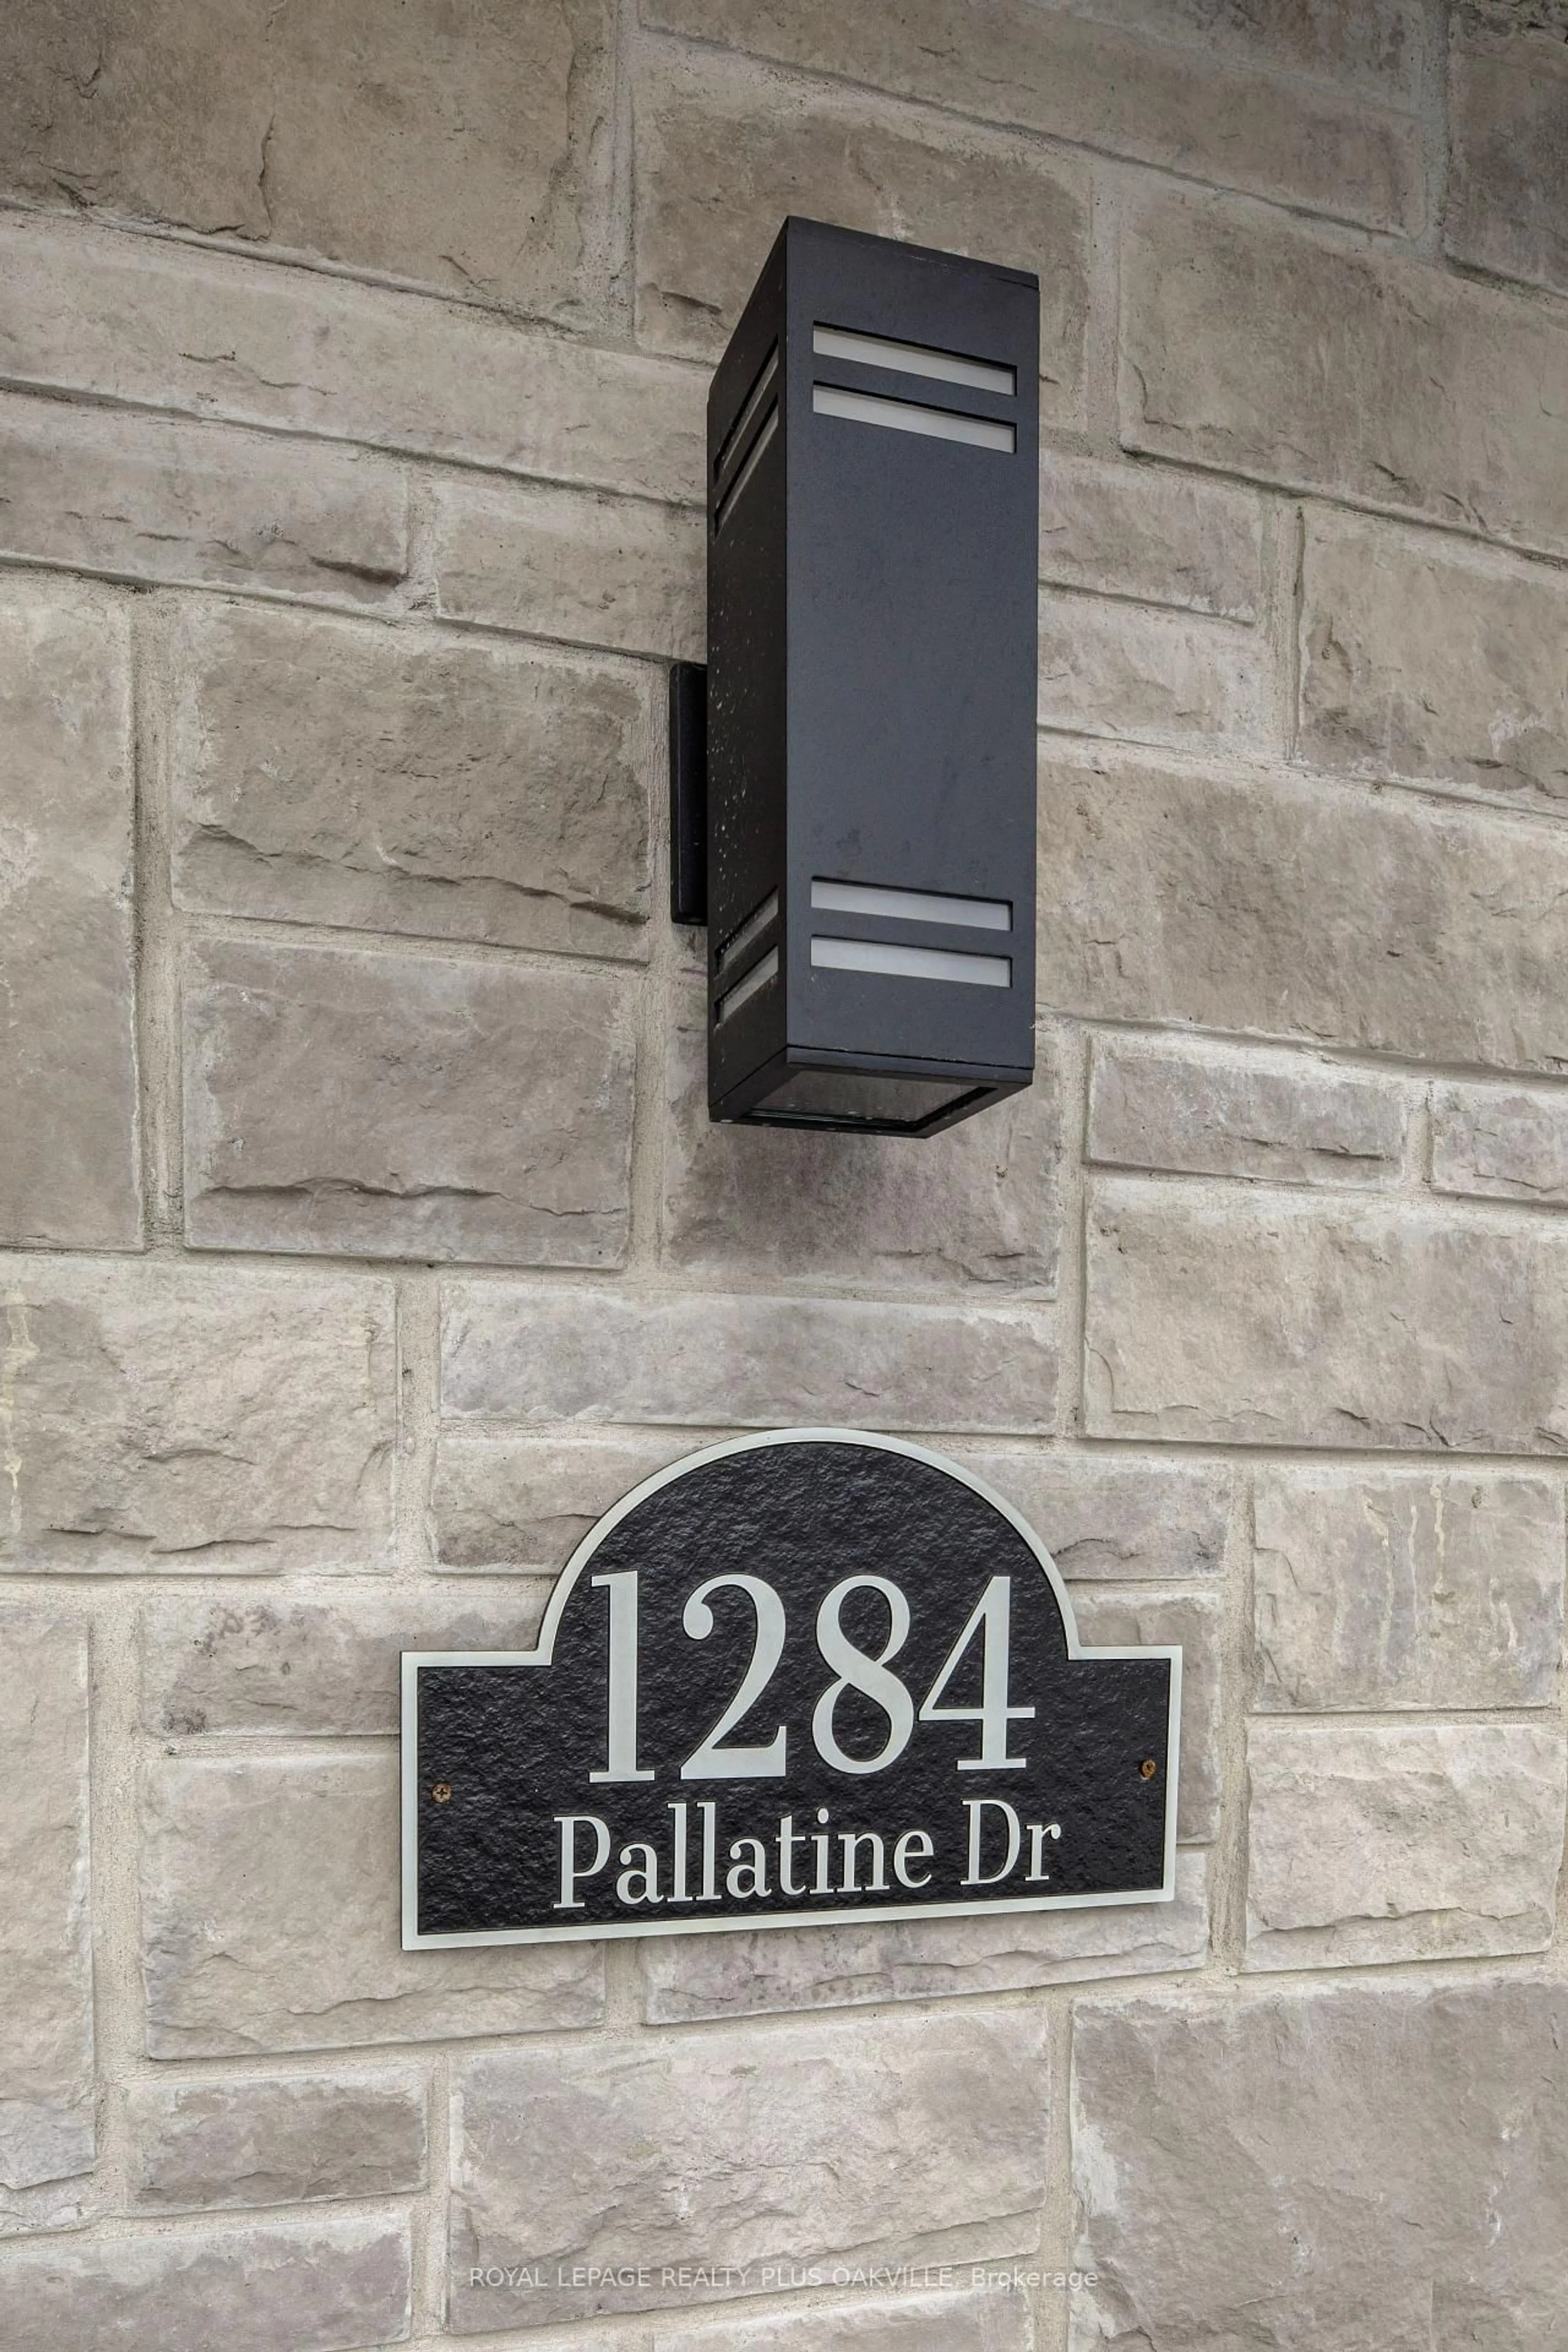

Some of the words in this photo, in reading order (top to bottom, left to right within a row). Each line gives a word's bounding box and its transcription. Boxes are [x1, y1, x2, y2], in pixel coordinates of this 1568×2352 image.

[590, 1571, 1035, 1782] 1284
[554, 1802, 933, 1908] Pallatine
[961, 1800, 1061, 1884] Dr
